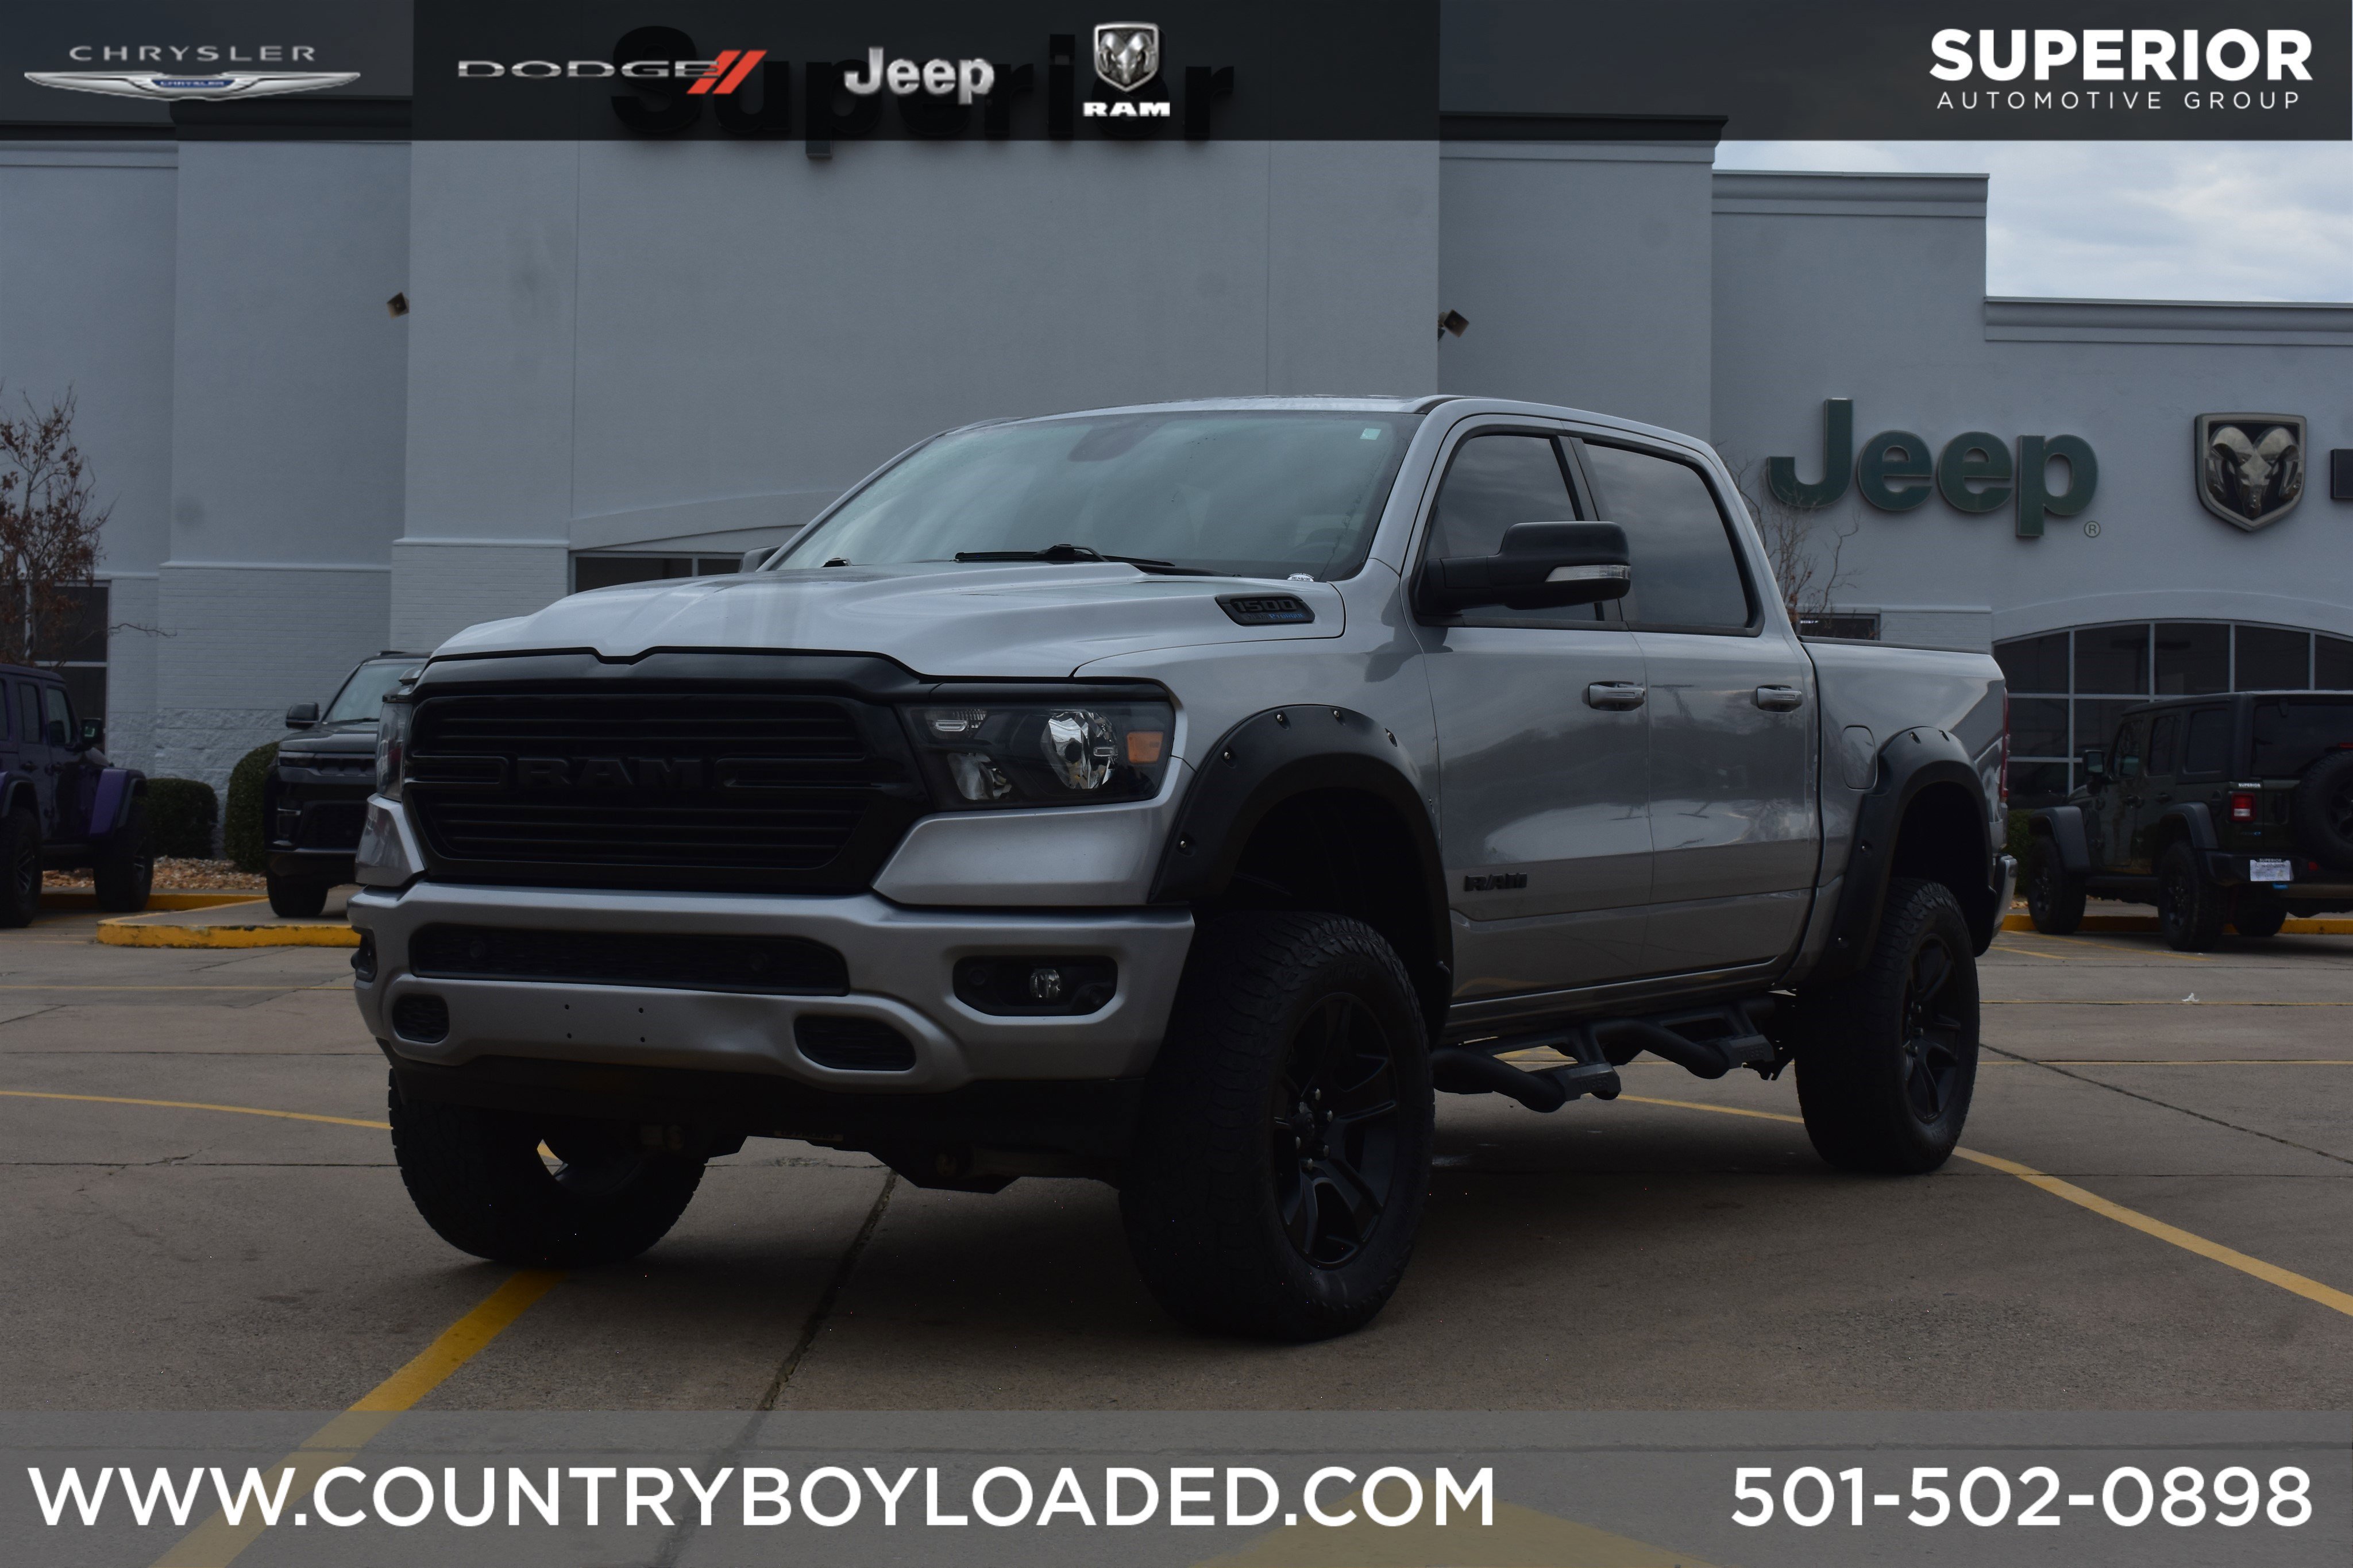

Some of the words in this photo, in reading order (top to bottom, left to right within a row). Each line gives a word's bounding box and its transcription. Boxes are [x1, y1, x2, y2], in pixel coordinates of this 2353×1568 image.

[1766, 397, 2099, 537] Jeep
[1235, 599, 1297, 612] 1500
[516, 756, 702, 790] RAM
[1464, 872, 1528, 891] RAM
